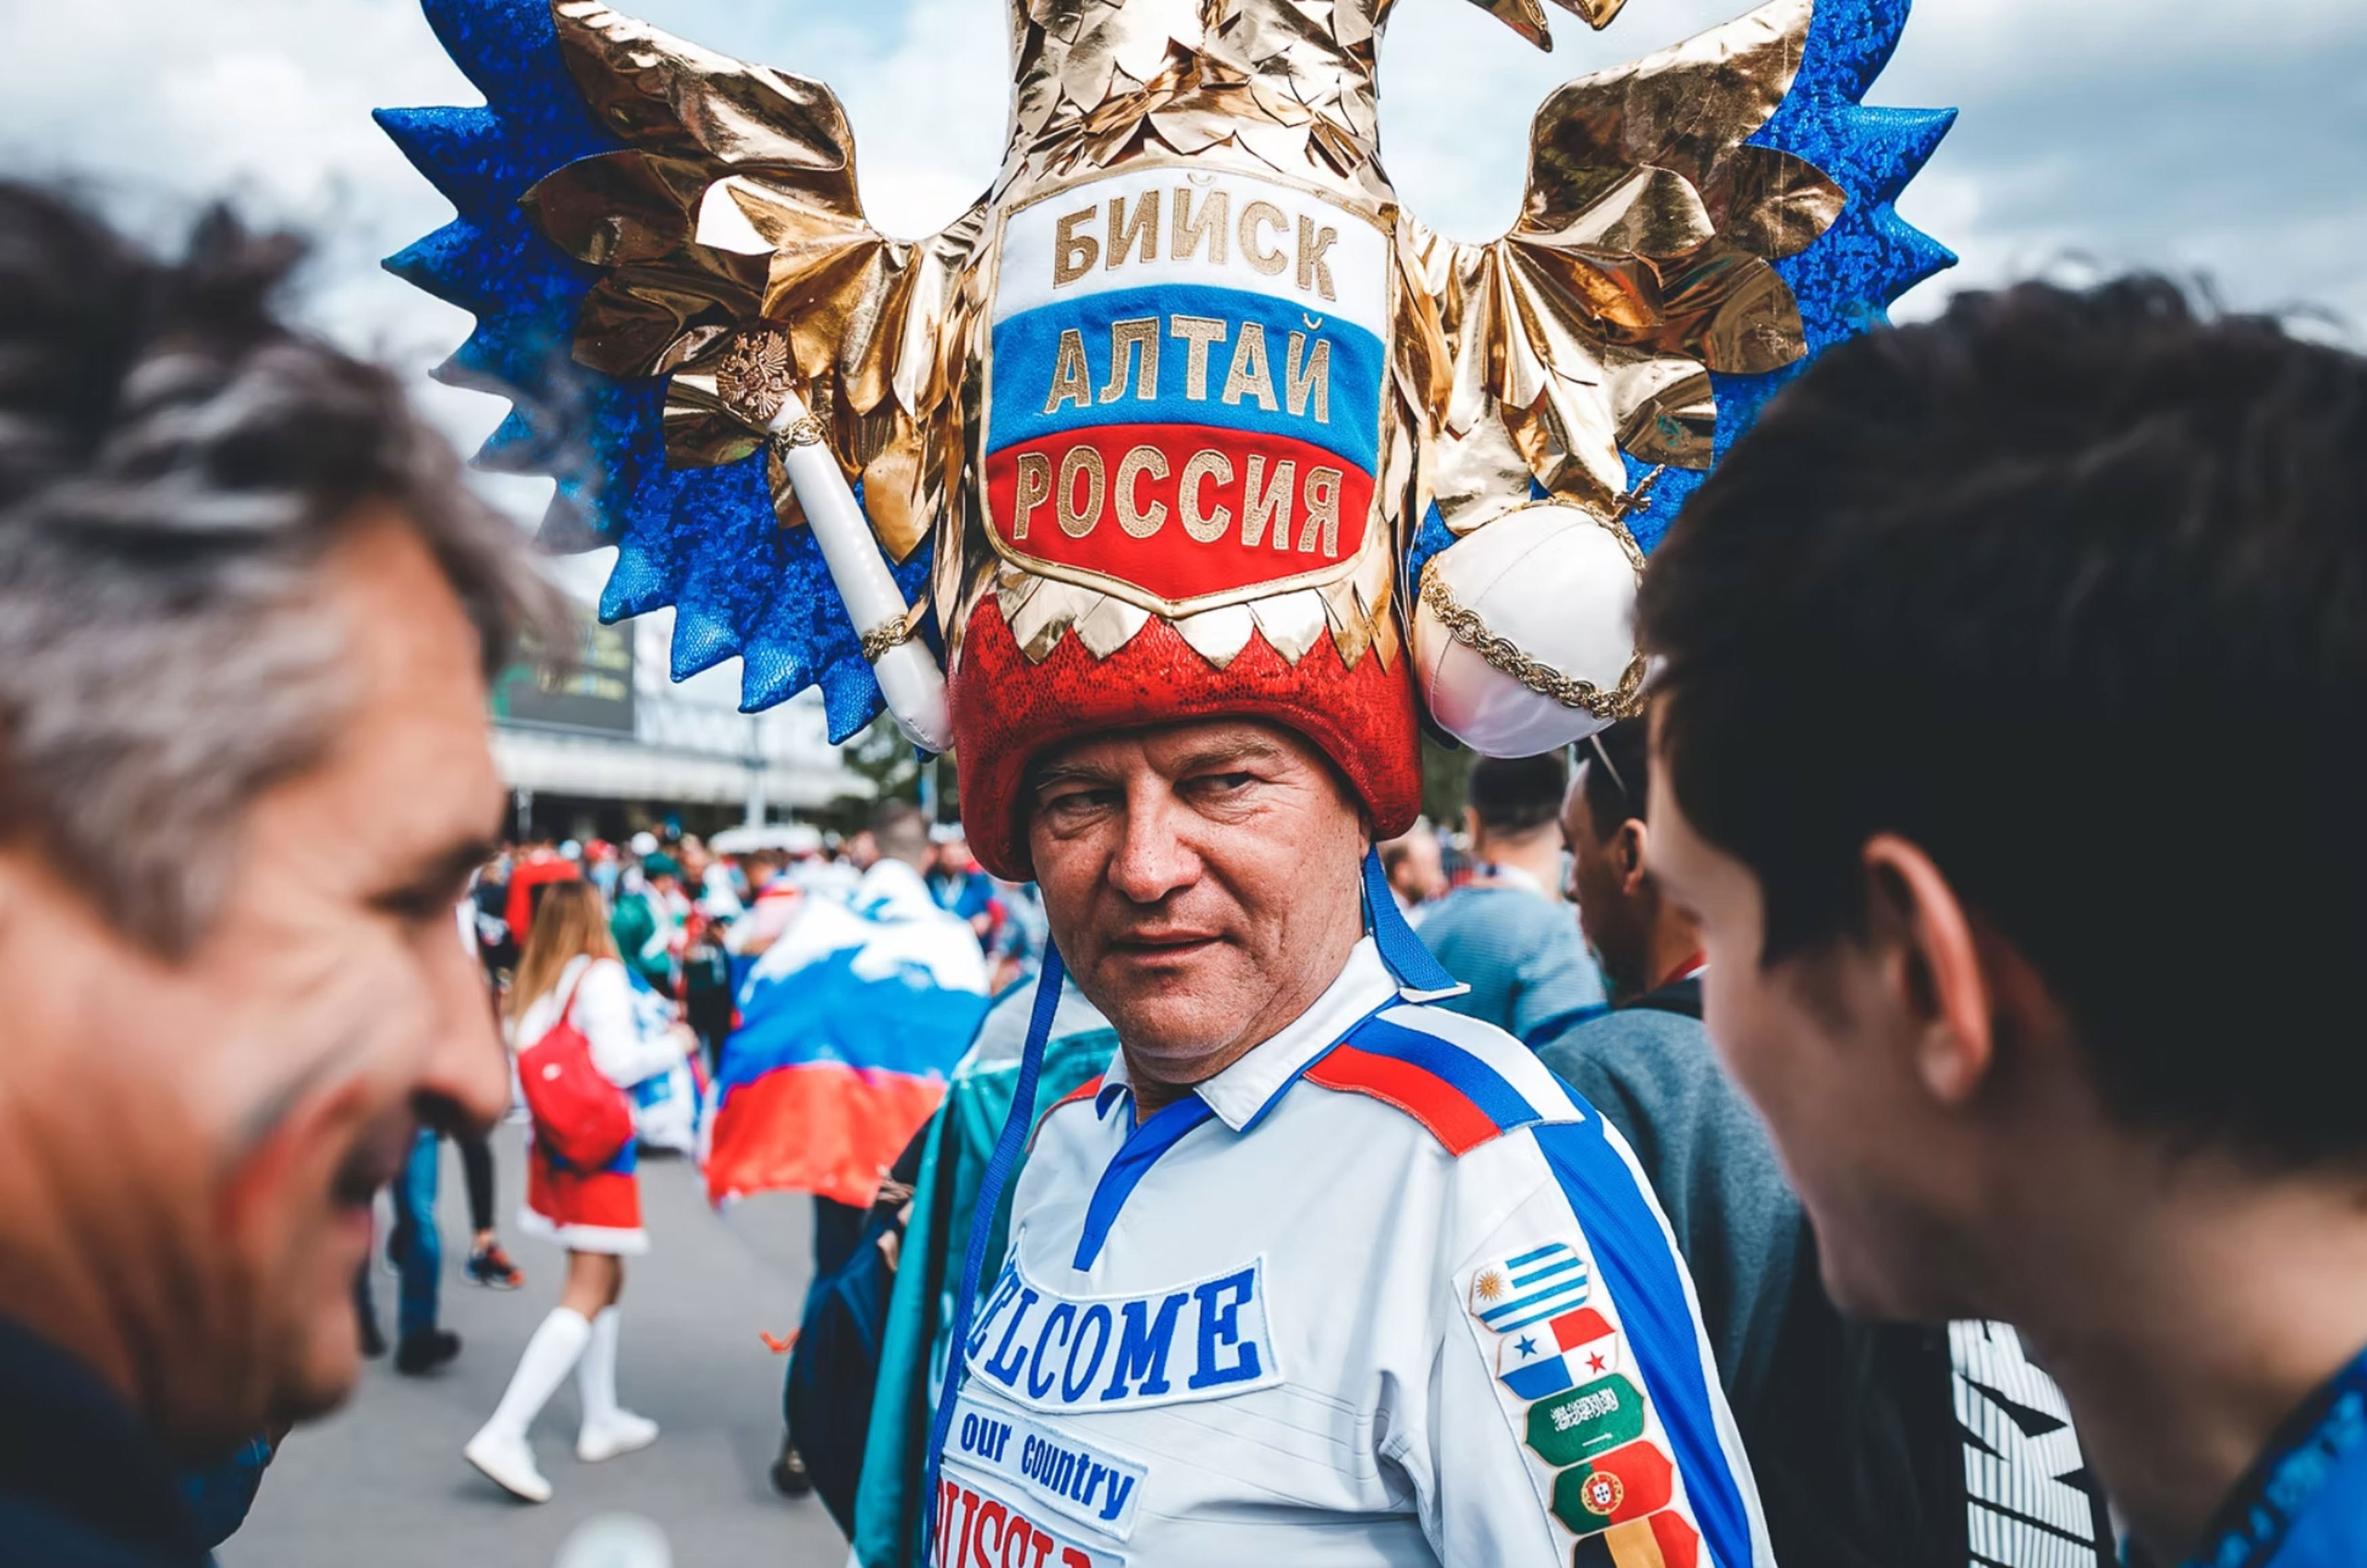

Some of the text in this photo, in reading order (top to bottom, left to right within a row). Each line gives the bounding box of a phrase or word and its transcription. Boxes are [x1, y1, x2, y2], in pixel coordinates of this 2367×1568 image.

[1053, 172, 1338, 301] БИЙСК
[1042, 312, 1331, 424] АЛТАЙ
[1013, 445, 1343, 557] РОССИЯ
[963, 1242, 1263, 1403] ELCOME
[960, 1412, 1135, 1521] our country
[1947, 1319, 2099, 1568] IKE
